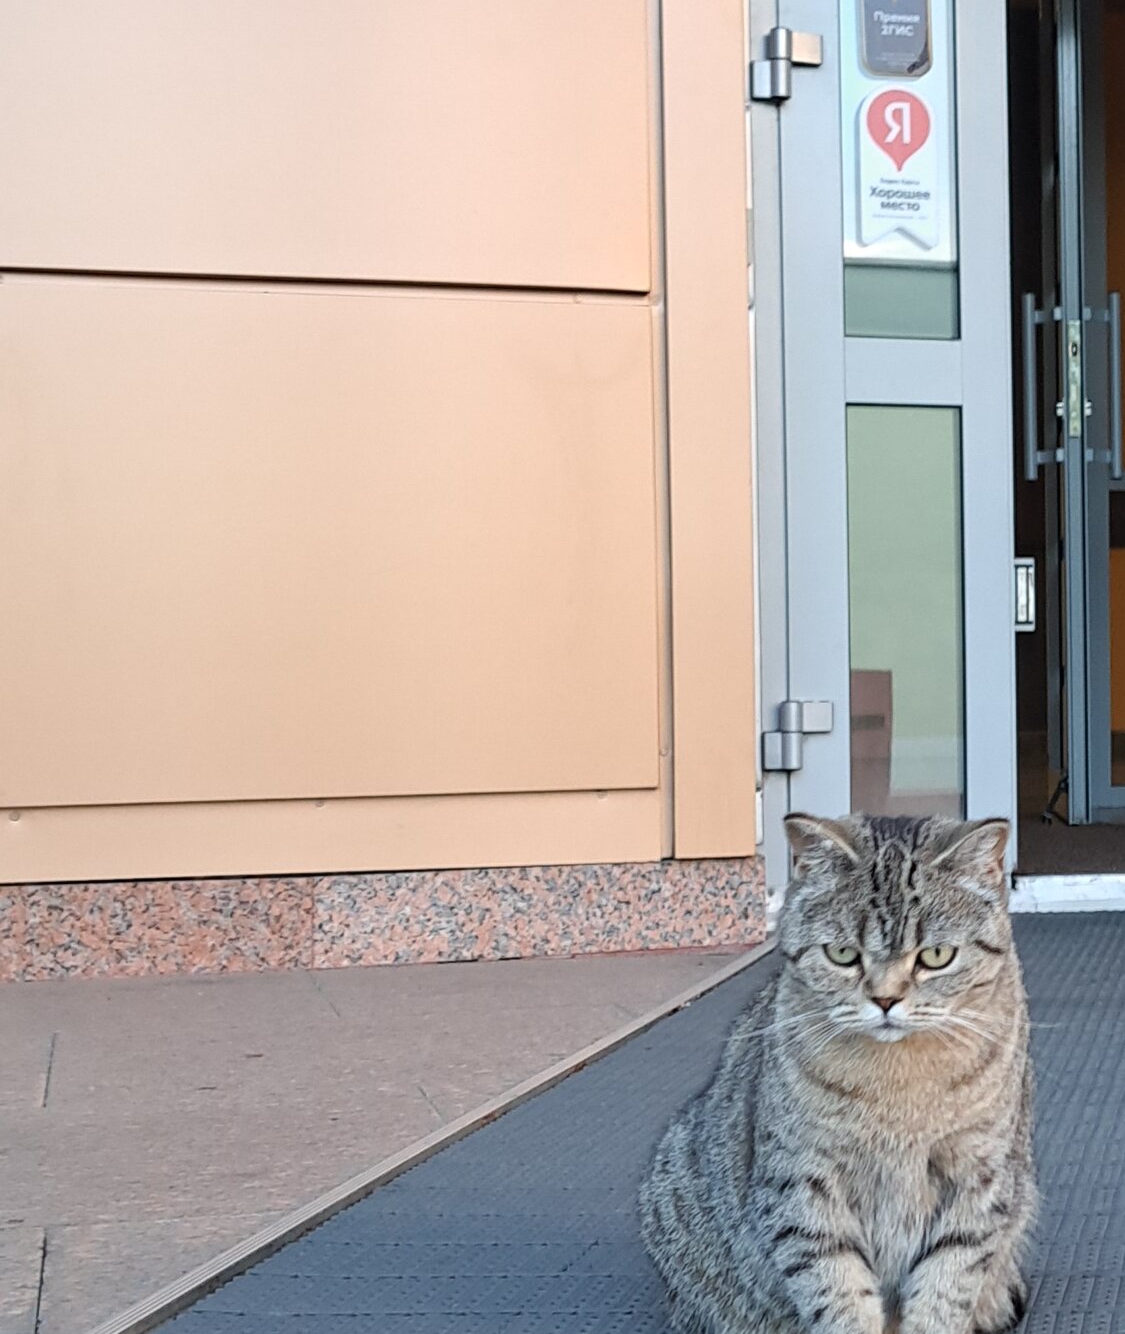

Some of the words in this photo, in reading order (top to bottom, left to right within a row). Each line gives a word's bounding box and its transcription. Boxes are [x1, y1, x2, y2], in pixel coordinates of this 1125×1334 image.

[873, 10, 921, 24] Премия
[880, 24, 914, 36] 2ГИС
[883, 100, 912, 145] Я
[870, 186, 931, 200] Хорошее
[880, 201, 921, 212] место
